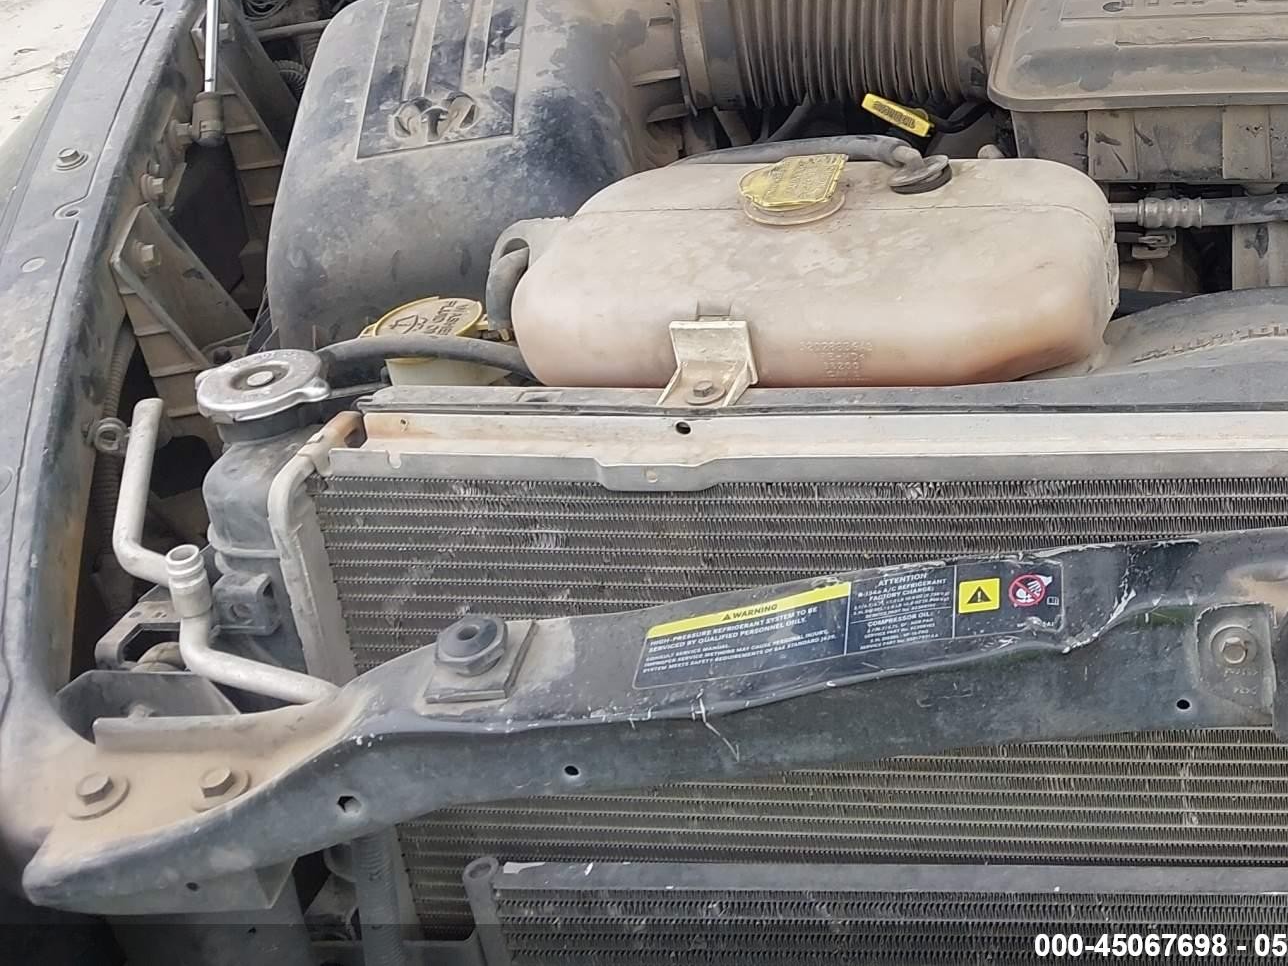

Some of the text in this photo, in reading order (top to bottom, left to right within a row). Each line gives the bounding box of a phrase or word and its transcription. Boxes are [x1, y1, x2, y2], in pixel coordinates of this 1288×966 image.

[878, 572, 927, 587] ATTENTION
[882, 585, 896, 593] A/C
[897, 578, 947, 591] REFRIGERANT
[869, 591, 901, 602] FACTORY
[733, 604, 778, 620] WARNING
[650, 606, 818, 646] HIGH-PRESSURE REFRIGERANT SYSTEM TO BE
[867, 614, 917, 627] COMPRESSOR
[648, 642, 686, 653] SERVICED
[686, 639, 698, 647] BY
[697, 631, 739, 644] QUALIFIED
[740, 623, 785, 637] PERSONNEL
[642, 665, 667, 674] SYSTEM
[668, 660, 689, 669] MEETS
[689, 657, 713, 666] SAFETY
[714, 647, 763, 662] REQUIREMENTS
[786, 638, 820, 649] STANDARD
[643, 658, 676, 667] IMPROPER
[677, 652, 703, 662] SERVICE
[750, 641, 772, 650] CAUSE
[645, 654, 675, 662] CONSULT
[675, 648, 701, 657] SERVICE
